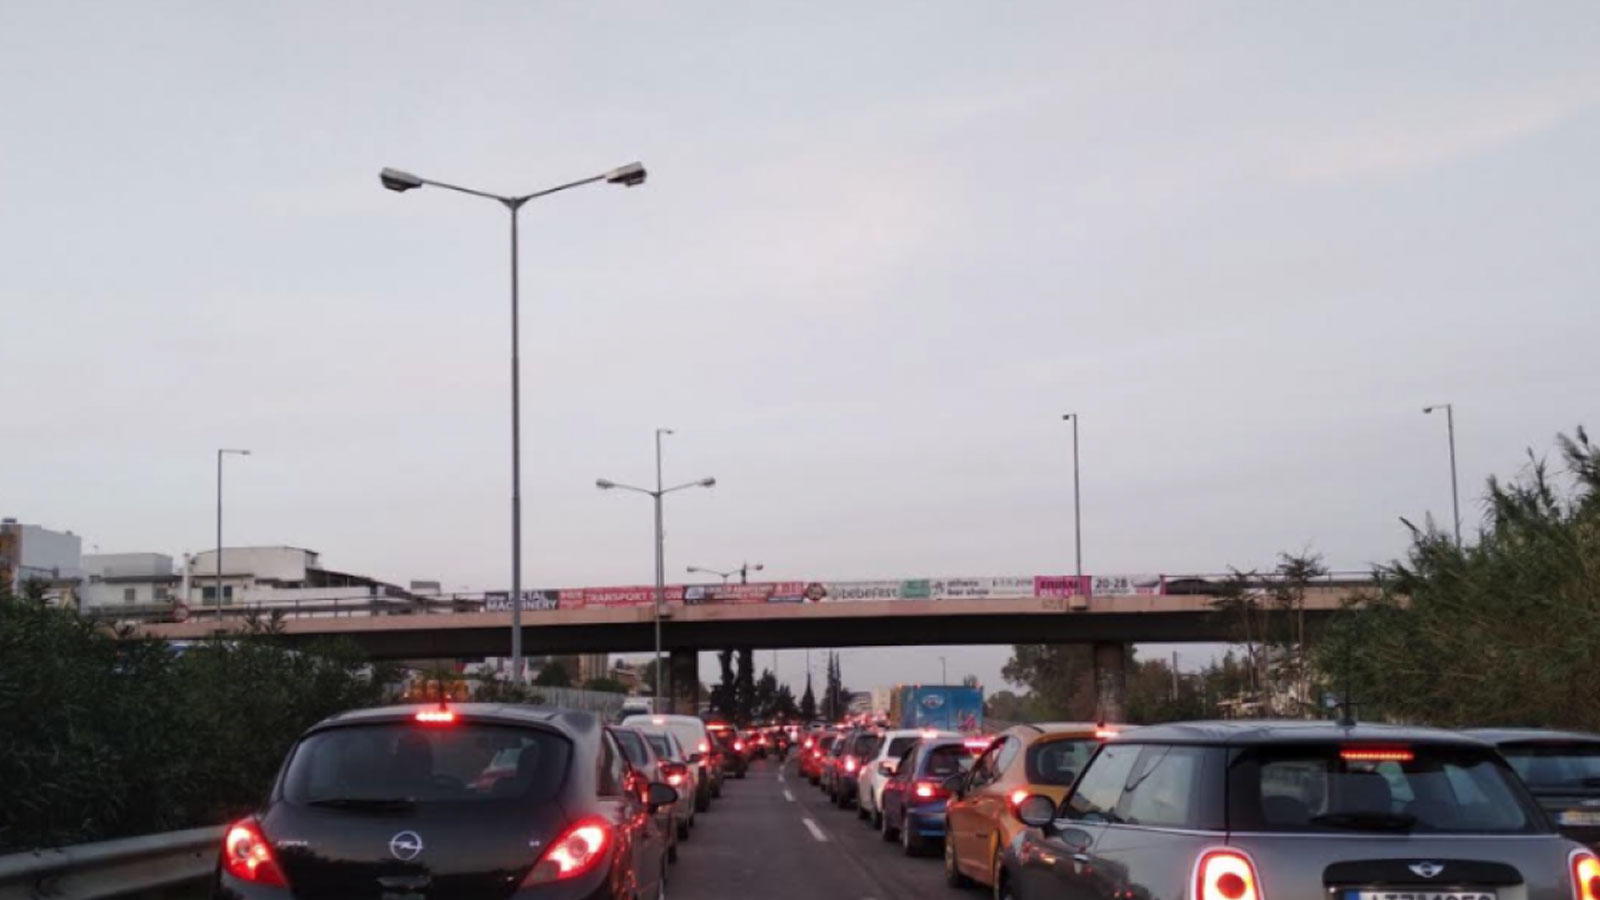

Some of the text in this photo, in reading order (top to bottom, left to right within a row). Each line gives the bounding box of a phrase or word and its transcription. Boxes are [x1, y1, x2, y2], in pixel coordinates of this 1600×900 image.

[1095, 577, 1128, 588] 20-28
[586, 592, 647, 602] TRANSPORT
[650, 590, 682, 600] SOW
